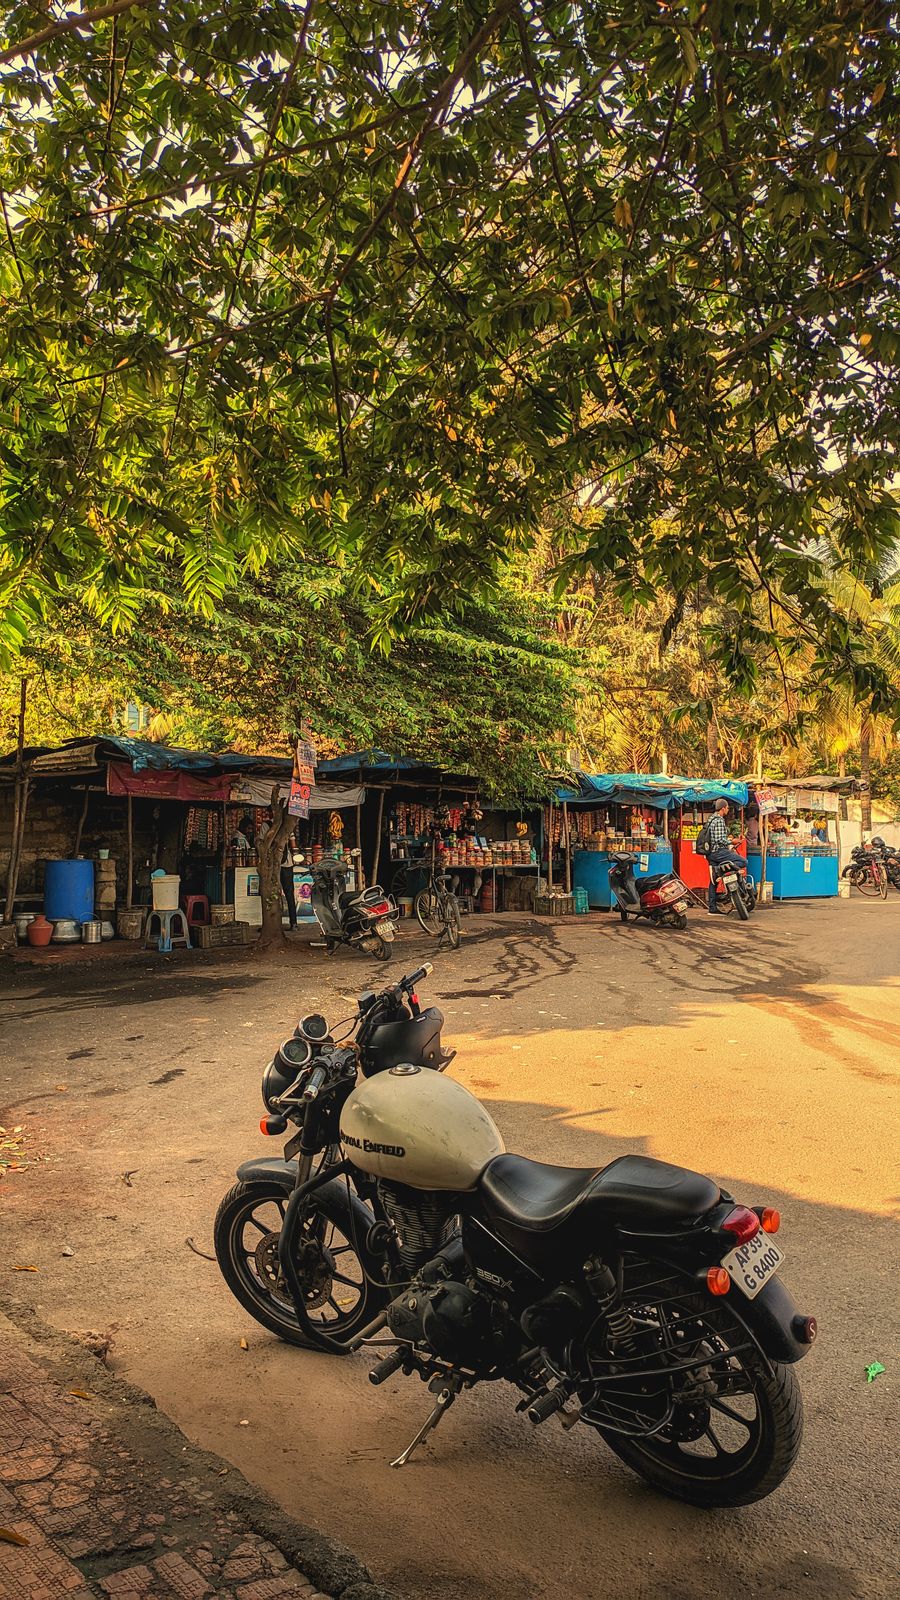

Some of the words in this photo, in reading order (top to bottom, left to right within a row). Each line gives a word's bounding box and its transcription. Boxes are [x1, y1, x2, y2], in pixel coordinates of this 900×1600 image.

[291, 783, 311, 800] PG
[756, 791, 772, 805] PG
[734, 1236, 763, 1268] AP39
[744, 1274, 757, 1290] G
[753, 1247, 780, 1281] 8400
